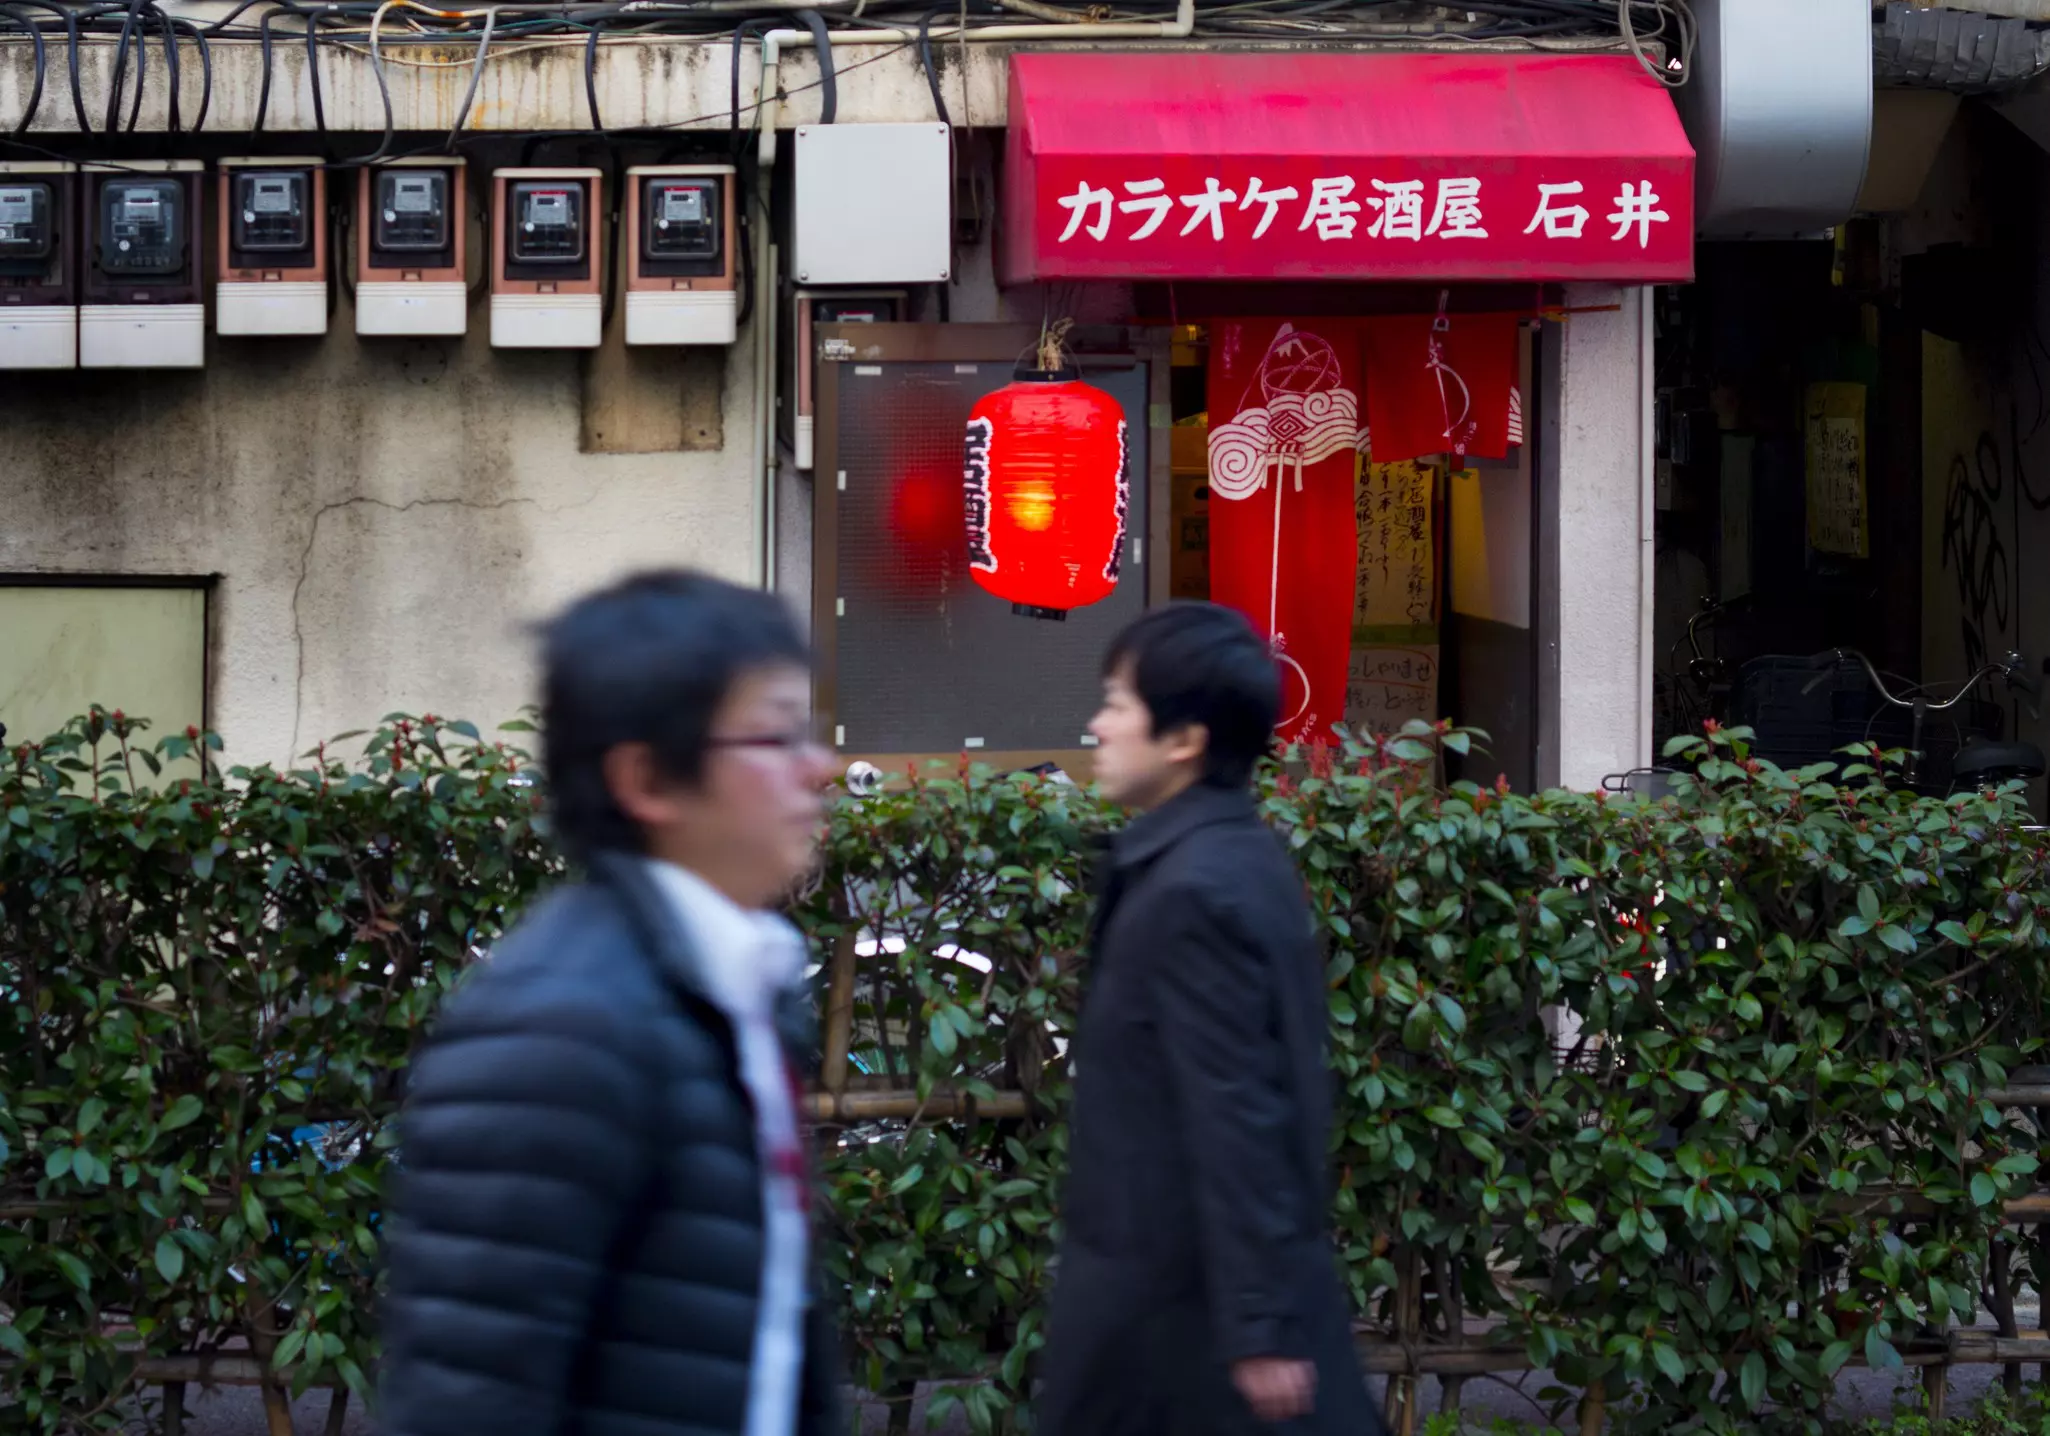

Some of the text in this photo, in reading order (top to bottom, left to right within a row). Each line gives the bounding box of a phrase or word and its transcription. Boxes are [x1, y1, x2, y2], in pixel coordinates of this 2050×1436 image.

[1057, 175, 1670, 249] カラオケ居酒屋 石井
